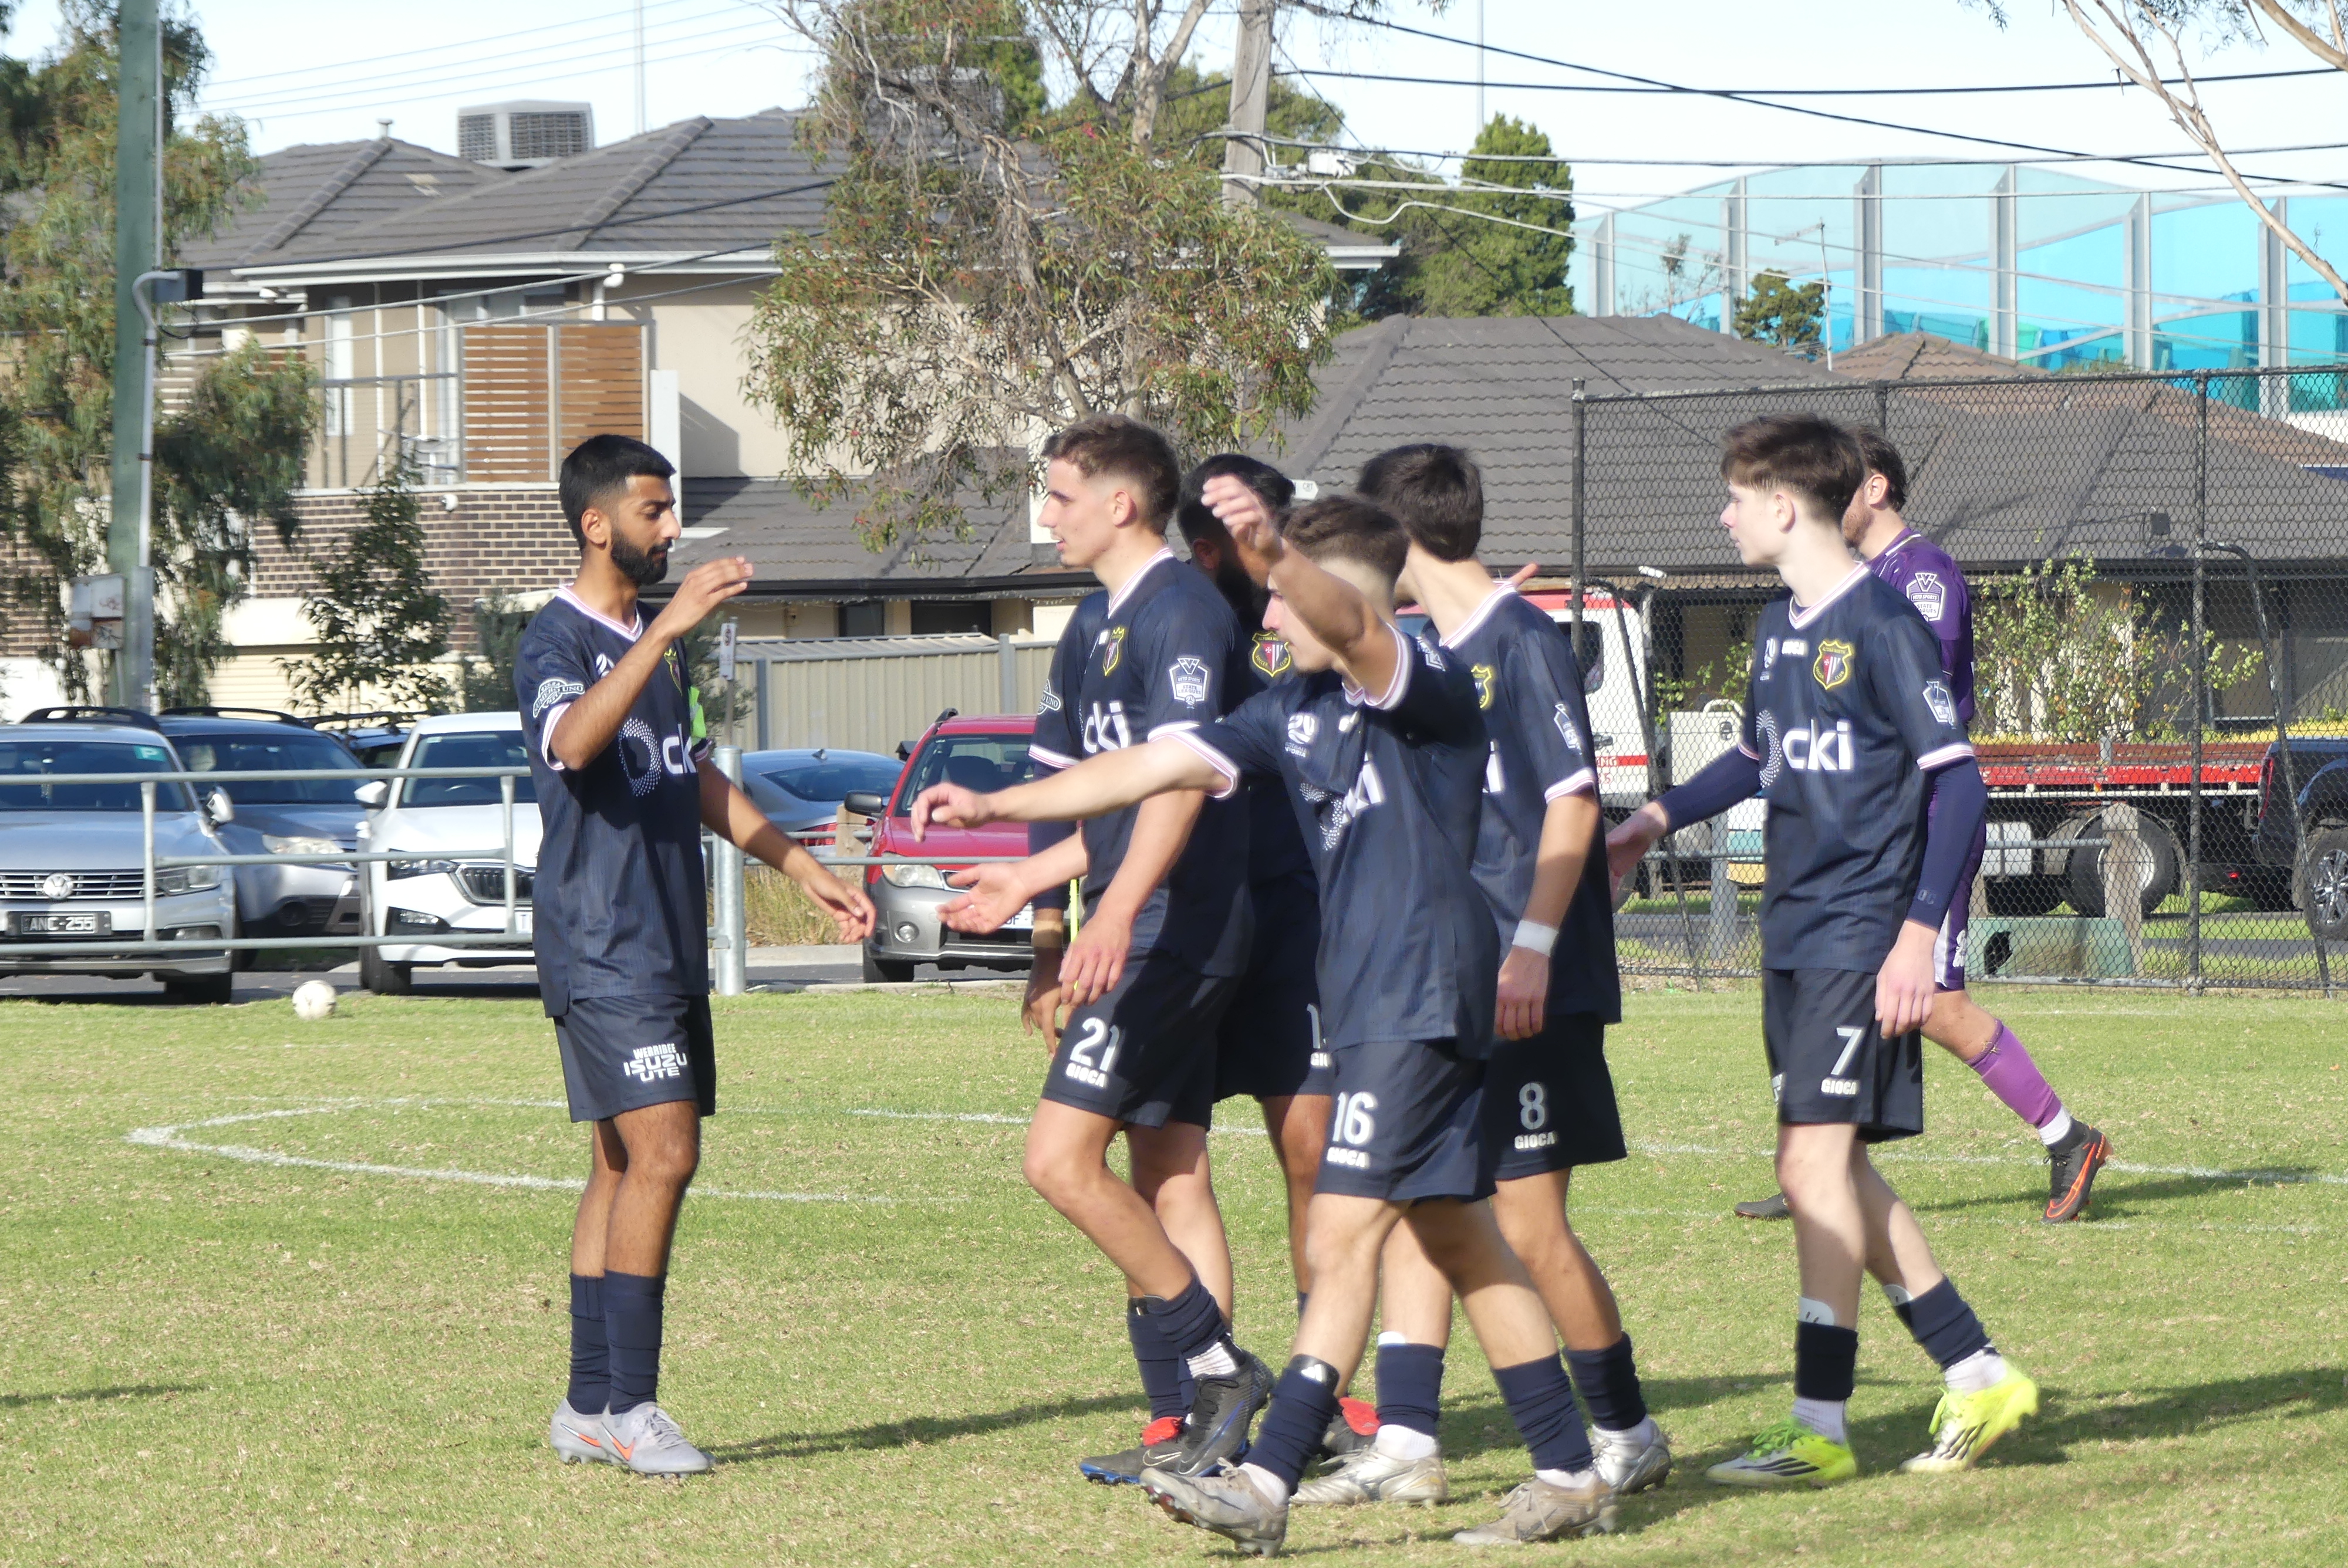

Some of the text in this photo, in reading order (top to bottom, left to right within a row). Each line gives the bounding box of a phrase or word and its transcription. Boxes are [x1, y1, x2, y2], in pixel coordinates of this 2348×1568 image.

[1046, 696, 1058, 708] UNO
[140, 746, 158, 758] P
[1070, 1017, 1120, 1072] 21
[1831, 1027, 1862, 1076] 7
[623, 1053, 687, 1076] ISUZU
[640, 1066, 680, 1082] UTE
[1066, 1063, 1105, 1087] GIOCA
[1821, 1079, 1857, 1095] GIOCA
[1519, 1082, 1546, 1130] 8
[1332, 1091, 1374, 1144] 16
[1514, 1132, 1556, 1149] GIOCA
[1327, 1147, 1366, 1167] GIOCA
